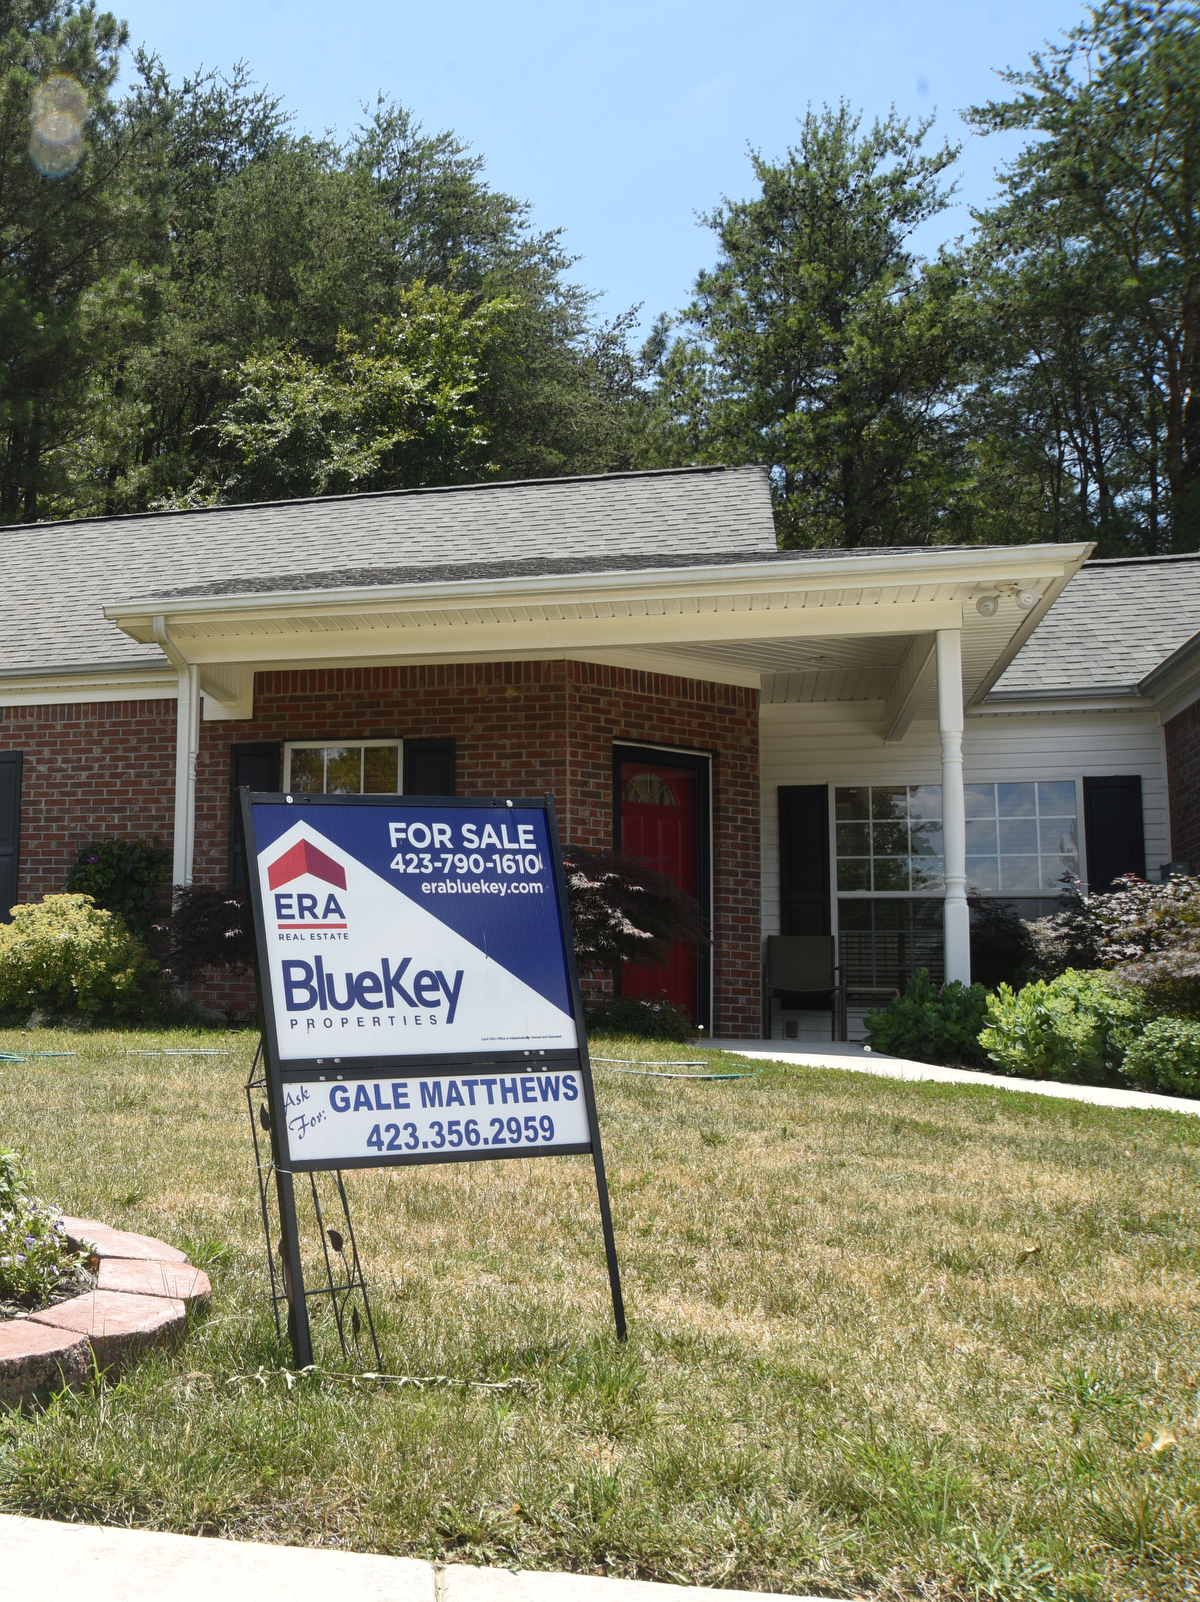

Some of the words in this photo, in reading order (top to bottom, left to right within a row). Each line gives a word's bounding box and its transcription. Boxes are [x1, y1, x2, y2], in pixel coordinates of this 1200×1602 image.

[388, 822, 454, 849] FOR
[461, 823, 537, 850] SALE
[390, 853, 540, 874] 423-790-1610
[421, 879, 544, 896] erabluekey.com
[274, 893, 347, 920] ERA
[278, 933, 306, 941] REAL
[309, 932, 349, 941] ESTATE
[281, 955, 464, 1025] BlueKey
[290, 1014, 438, 1030] PROPERTIES
[284, 1085, 310, 1116] Ask
[329, 1083, 411, 1113] GALE
[419, 1075, 579, 1109] MATTHEWS
[289, 1110, 327, 1140] For:
[366, 1115, 555, 1152] 423.356.2959
